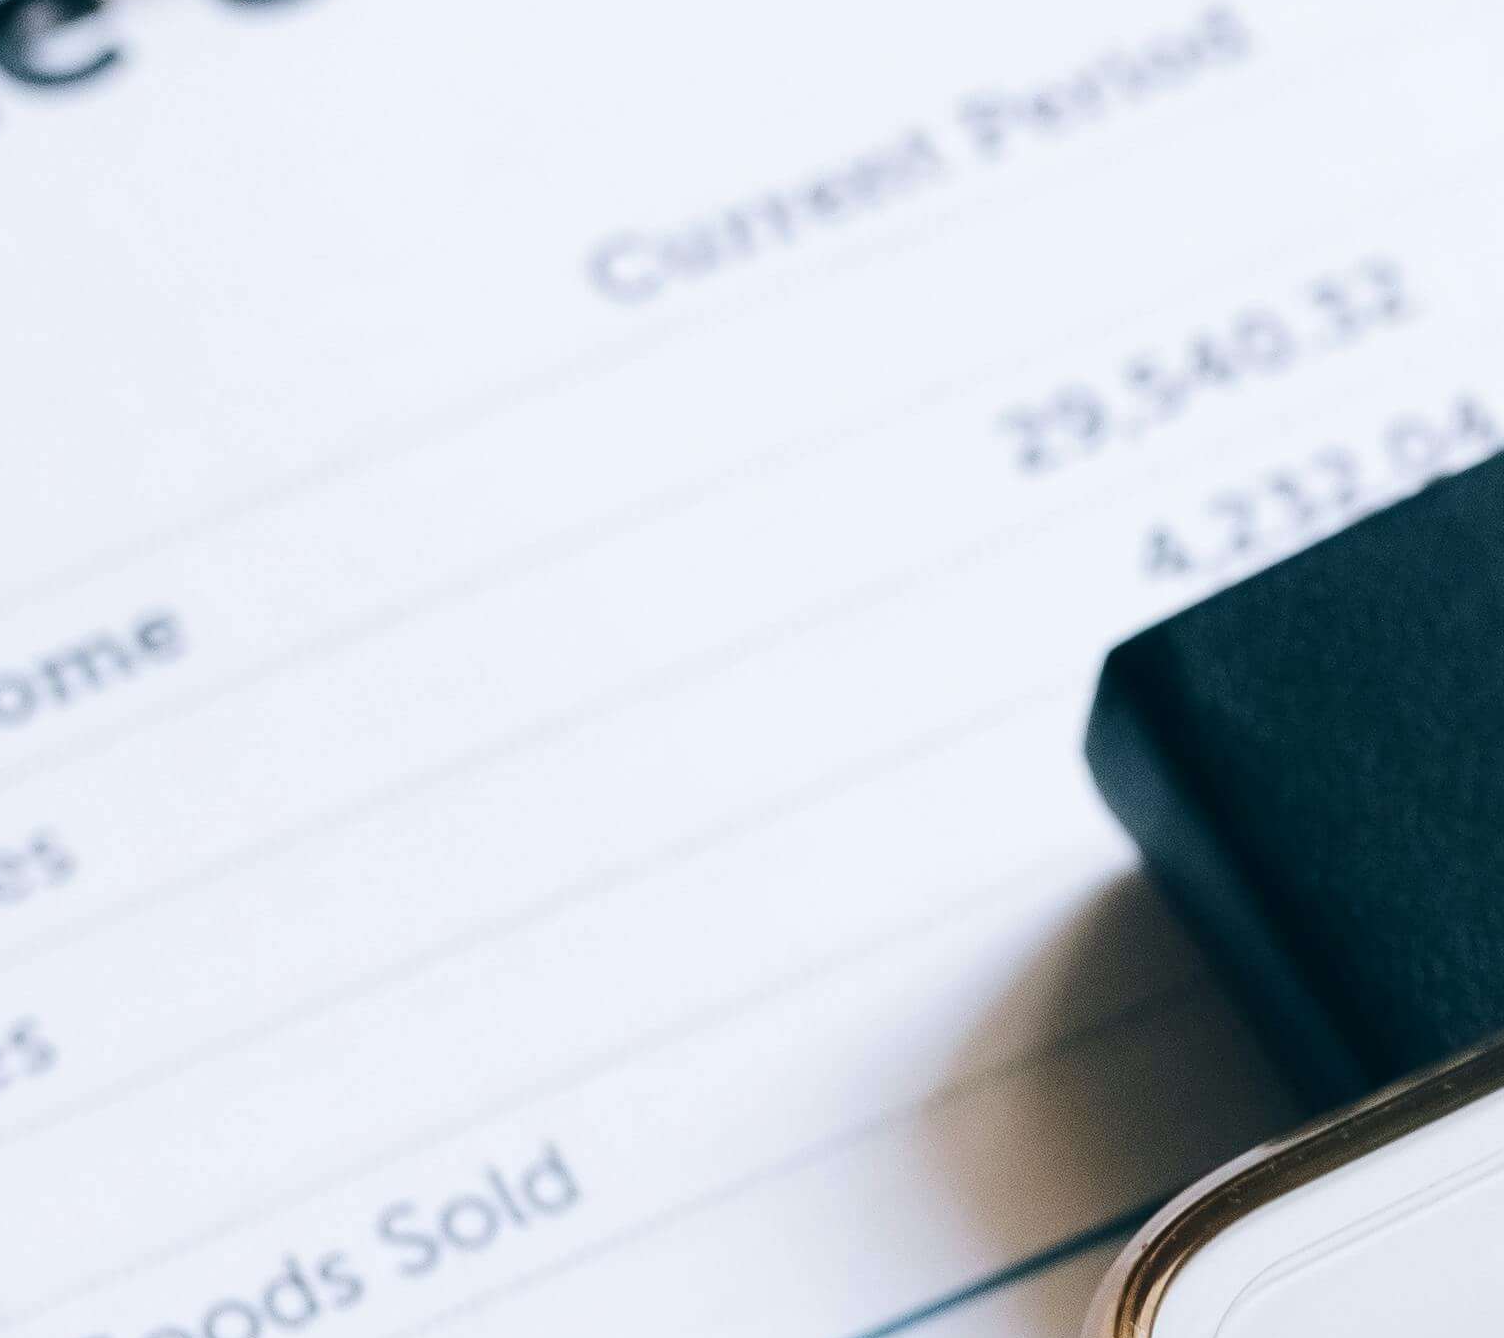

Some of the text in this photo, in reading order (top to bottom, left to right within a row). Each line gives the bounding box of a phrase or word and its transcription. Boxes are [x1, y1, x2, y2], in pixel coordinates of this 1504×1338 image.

[582, 125, 947, 307] Current
[953, 1, 1254, 164] Period
[373, 1139, 585, 1281] Sold
